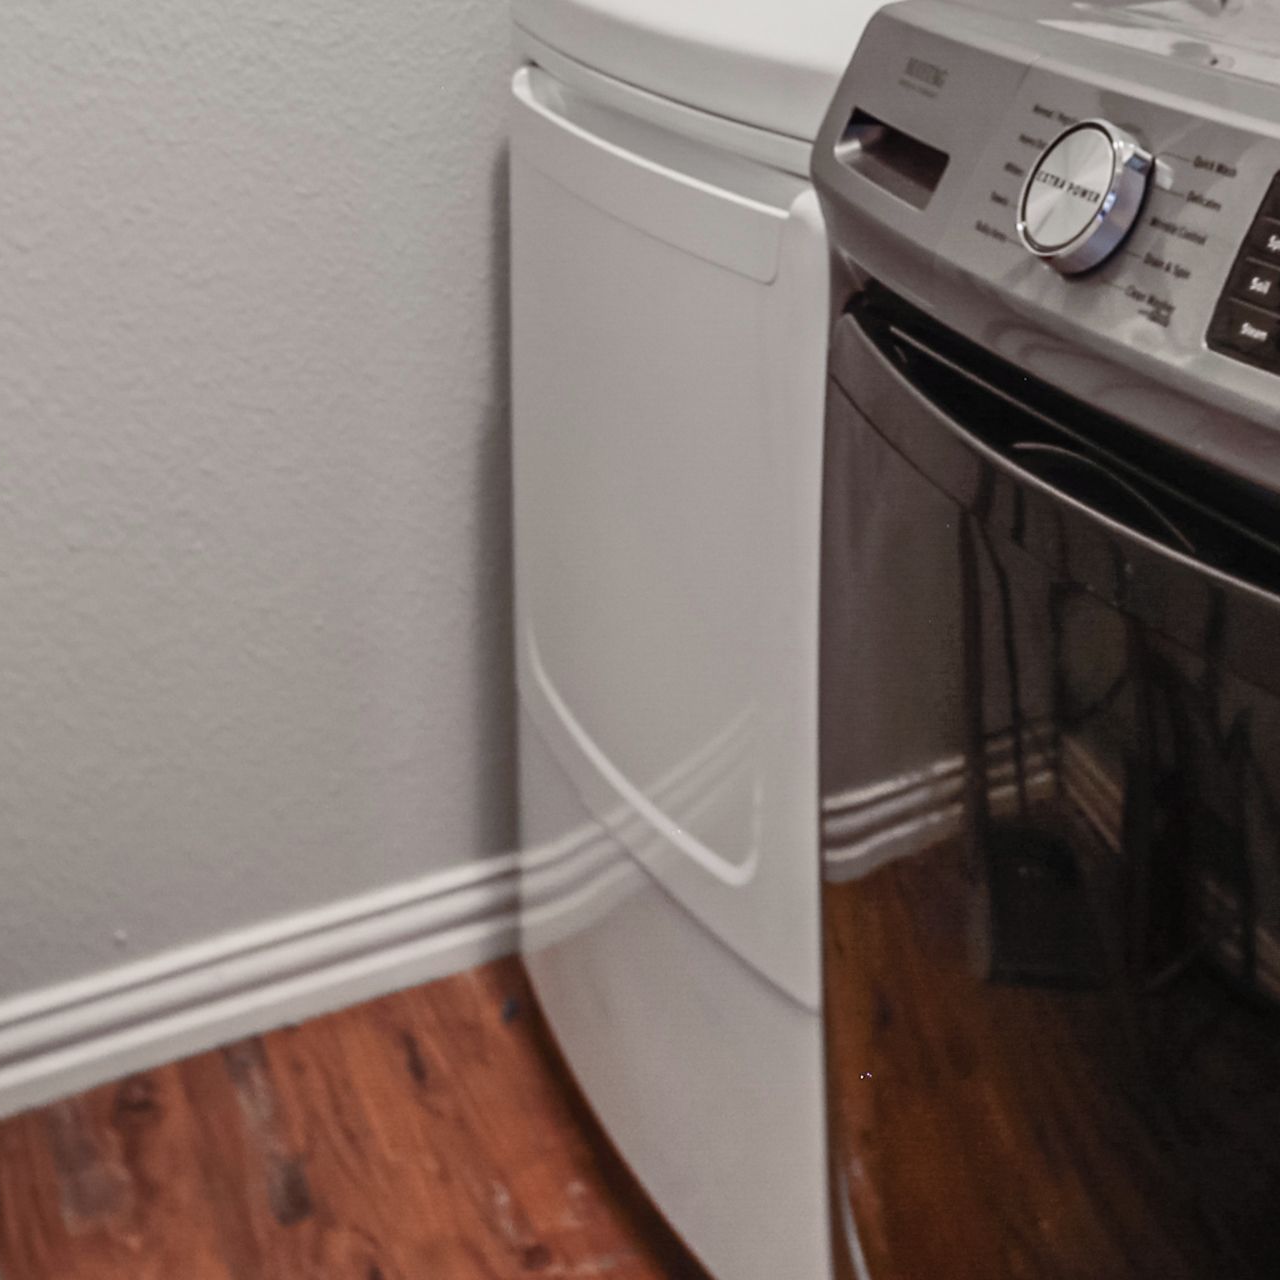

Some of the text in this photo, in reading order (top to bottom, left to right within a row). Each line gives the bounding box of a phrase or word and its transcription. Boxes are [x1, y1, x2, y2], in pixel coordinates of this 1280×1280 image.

[1035, 171, 1101, 203] EXTRA POWER
[1249, 276, 1272, 295] Soil
[1240, 321, 1268, 342] Steam
